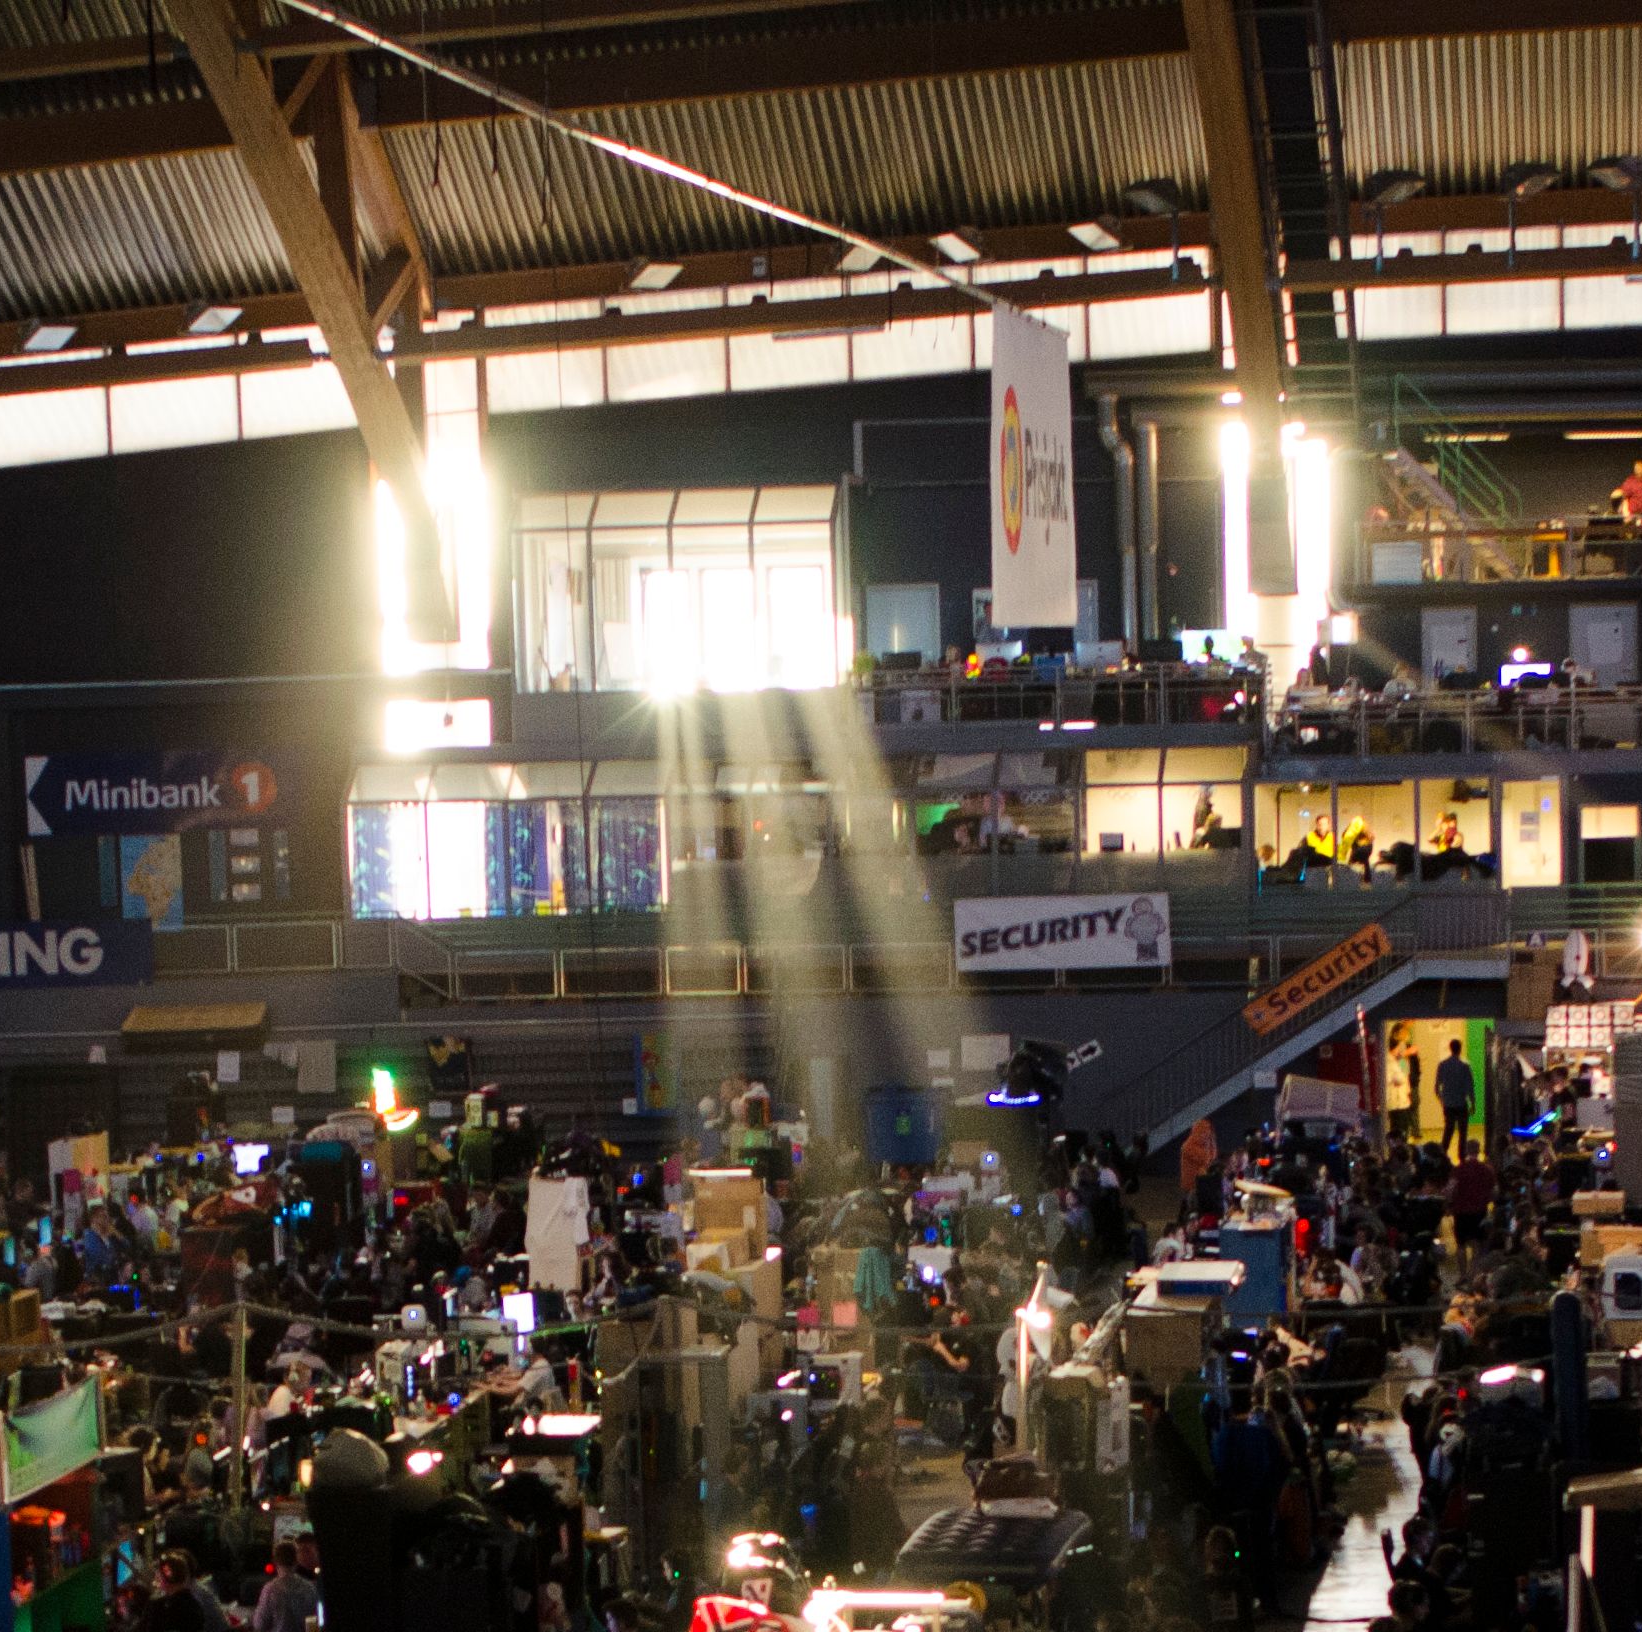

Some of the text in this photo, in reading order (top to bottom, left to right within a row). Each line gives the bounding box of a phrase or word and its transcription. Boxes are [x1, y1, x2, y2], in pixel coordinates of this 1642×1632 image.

[65, 776, 222, 812] Minibank
[960, 906, 1128, 957] SECURITY
[1267, 929, 1383, 1018] Security
